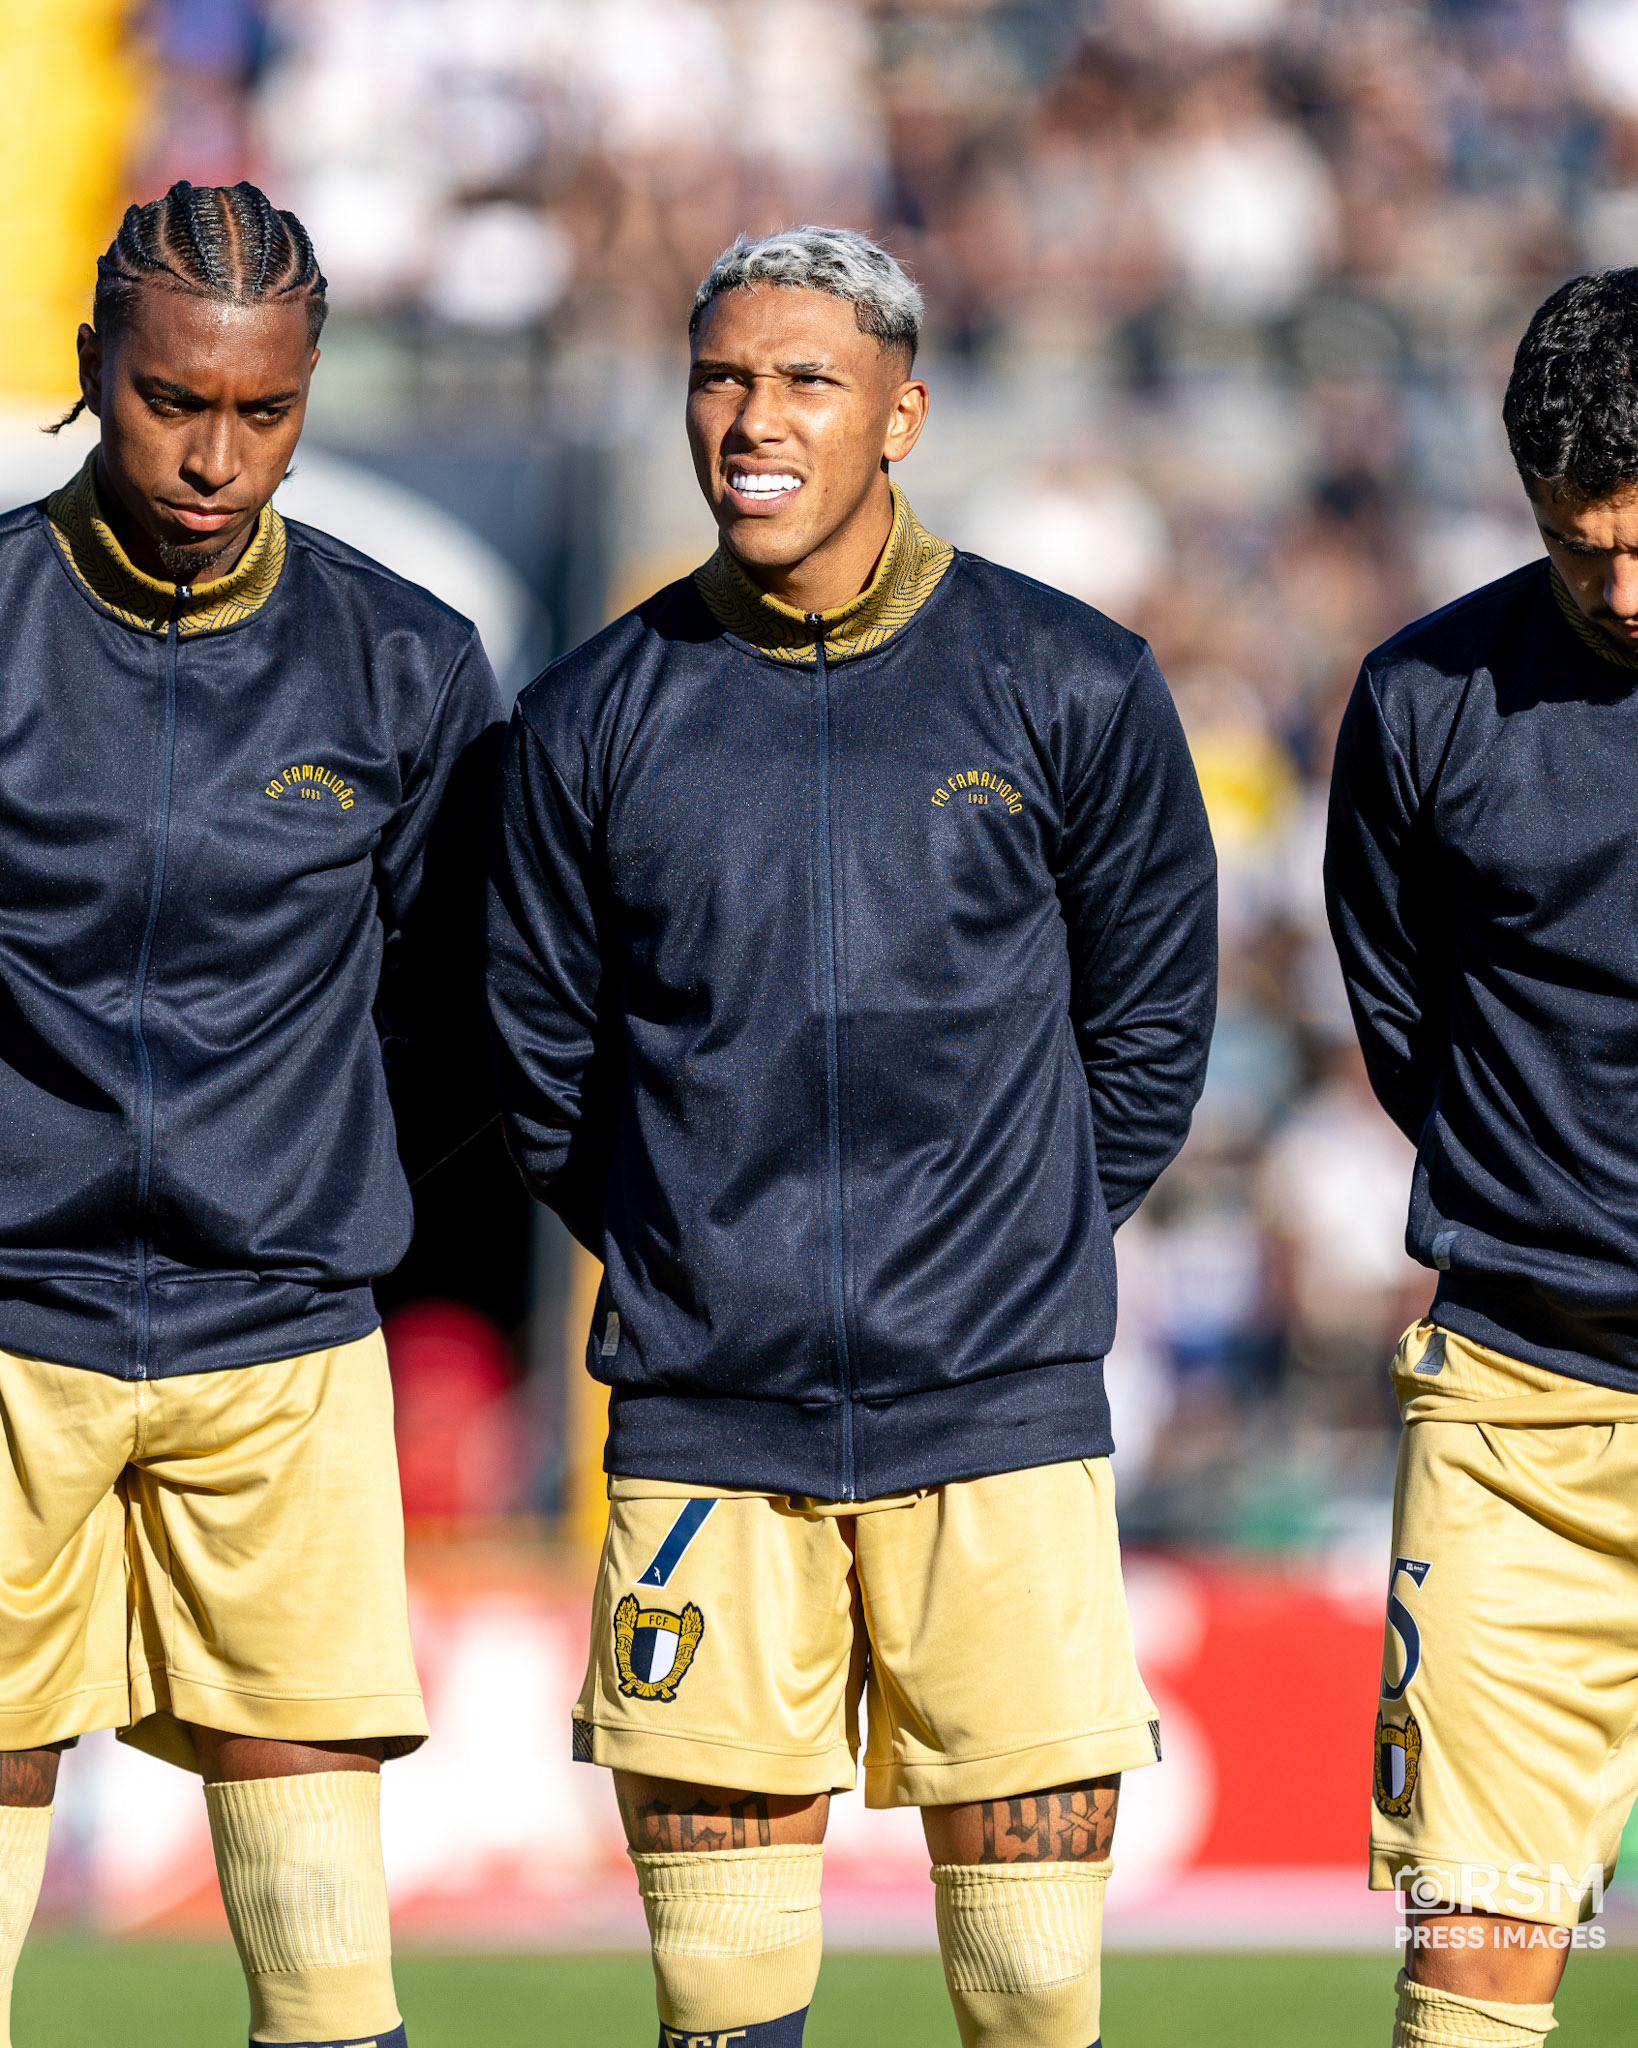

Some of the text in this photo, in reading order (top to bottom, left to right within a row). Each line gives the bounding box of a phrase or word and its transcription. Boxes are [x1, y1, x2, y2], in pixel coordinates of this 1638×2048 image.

[301, 788, 320, 800] 1931
[968, 793, 988, 805] 1931
[649, 1614, 669, 1627] FCF
[1386, 1731, 1397, 1742] FCF
